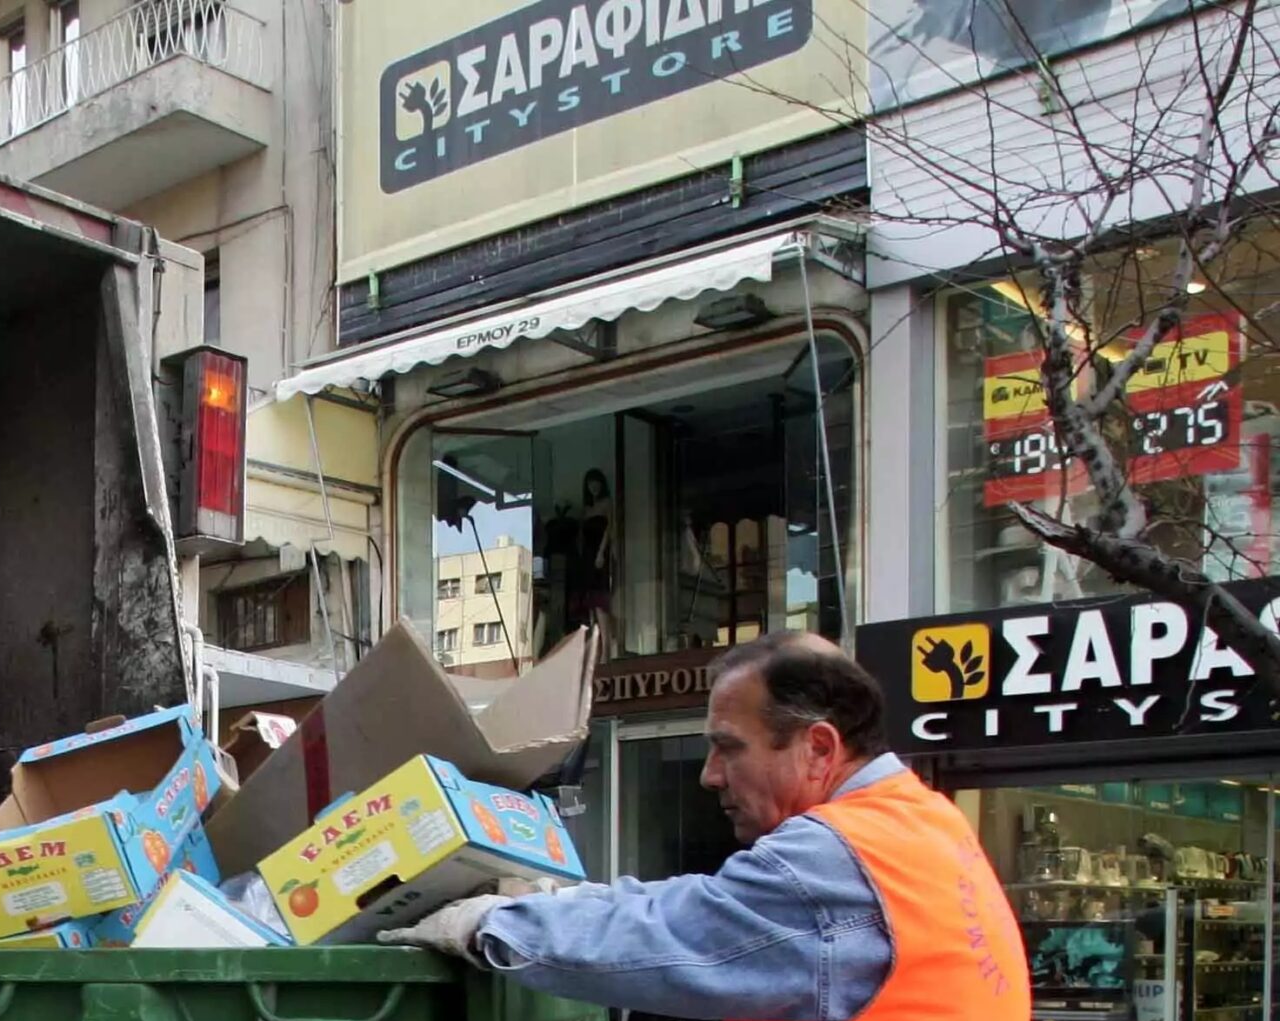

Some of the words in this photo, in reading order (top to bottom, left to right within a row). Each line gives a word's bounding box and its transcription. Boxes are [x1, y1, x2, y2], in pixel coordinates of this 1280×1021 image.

[394, 8, 794, 172] CITYSTORE
[456, 325, 514, 349] ΕΡΜΟΥ
[518, 317, 540, 333] 29
[1178, 348, 1208, 370] TV
